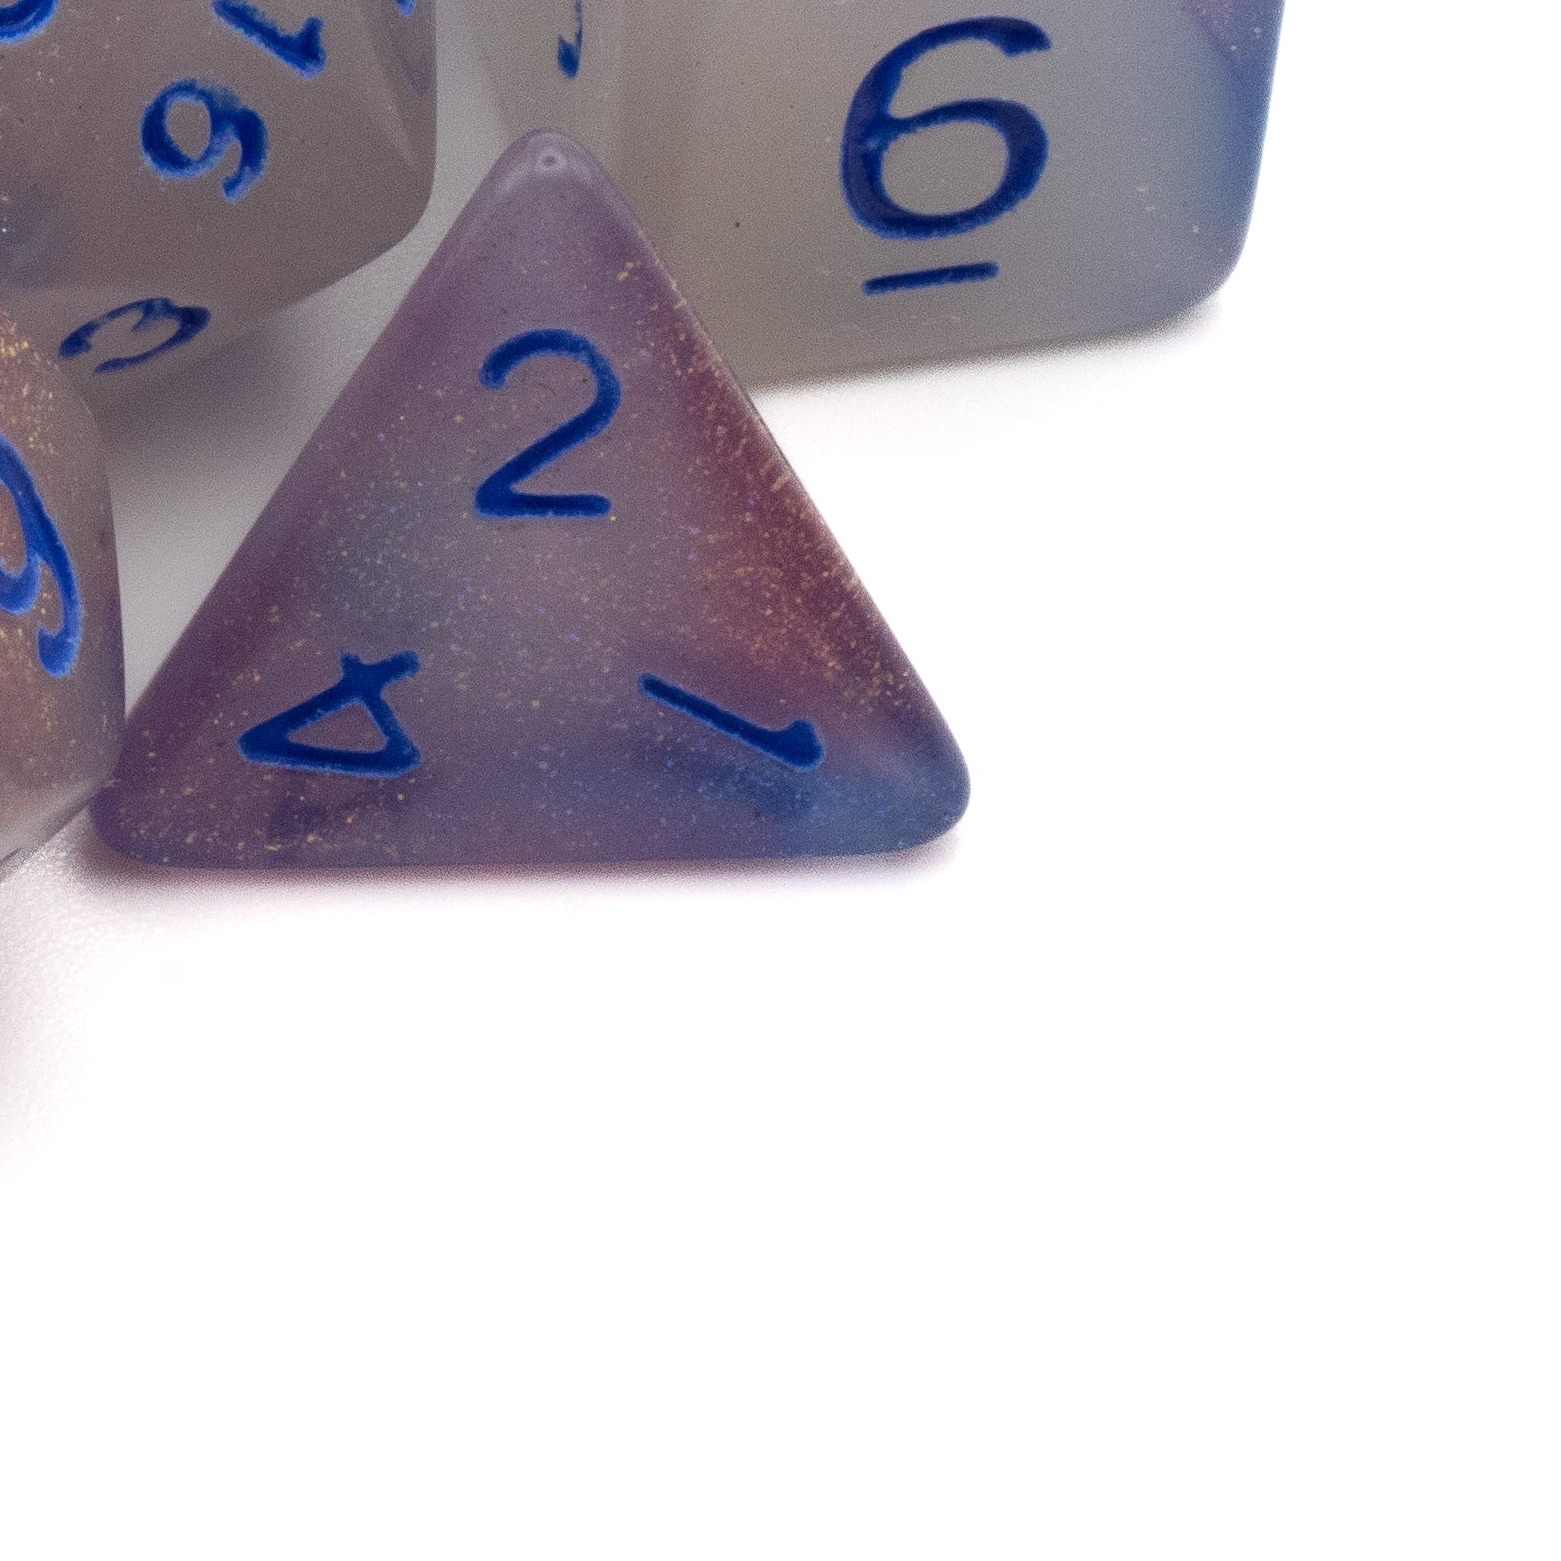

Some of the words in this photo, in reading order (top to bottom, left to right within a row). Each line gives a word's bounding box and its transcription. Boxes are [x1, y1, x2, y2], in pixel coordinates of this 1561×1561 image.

[840, 14, 1054, 296] 6
[59, 297, 212, 375] 3
[474, 326, 622, 520] 2
[238, 649, 422, 778] 4
[636, 672, 826, 772] 1
